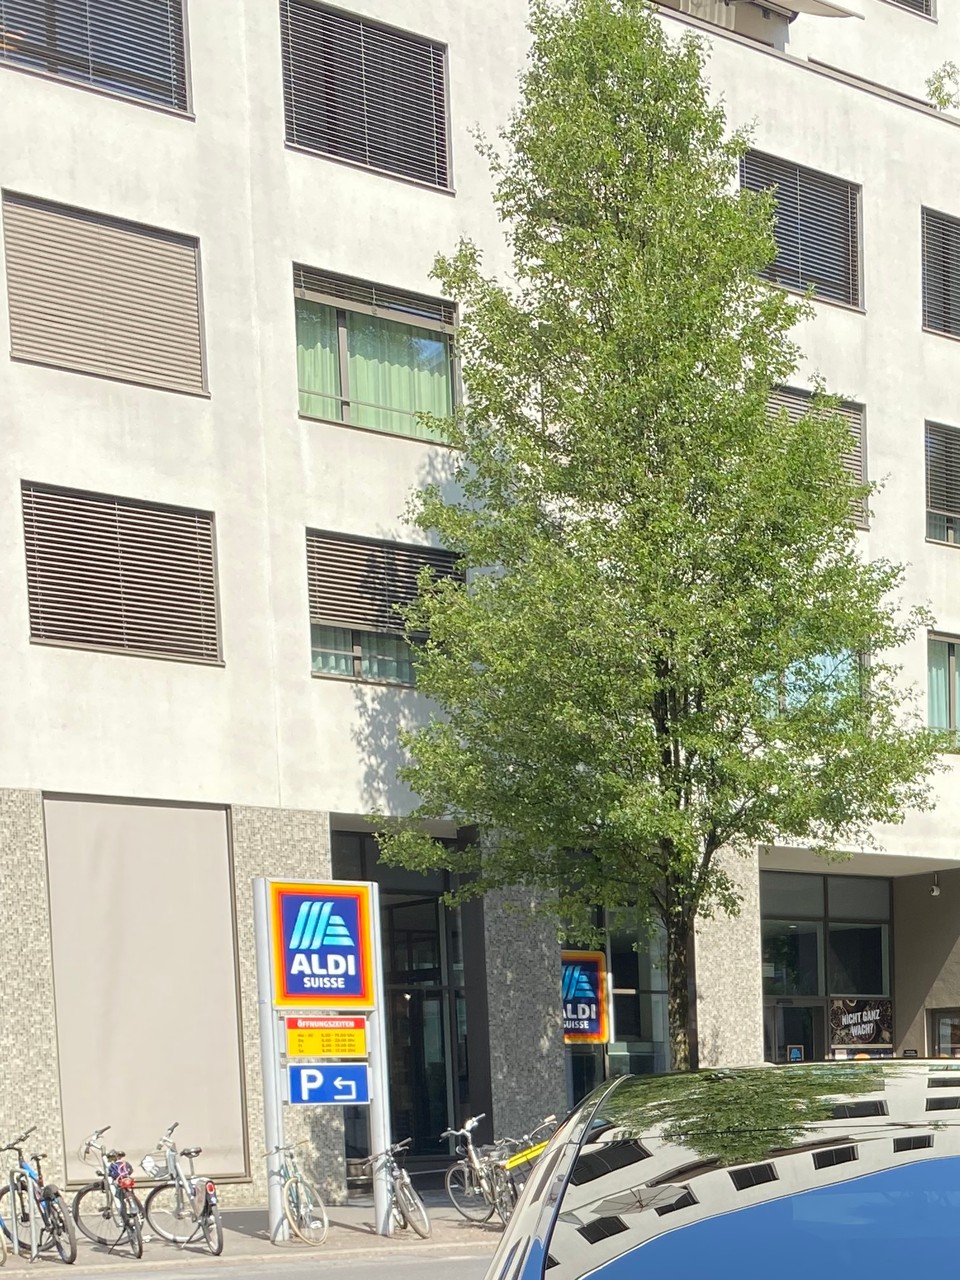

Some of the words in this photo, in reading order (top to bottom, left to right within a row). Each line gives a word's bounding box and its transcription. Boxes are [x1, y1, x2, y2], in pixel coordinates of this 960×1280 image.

[290, 953, 356, 975] ALDI
[303, 977, 345, 988] SUISSE
[297, 1018, 355, 1028] ÖFFNUNGSZEITEN
[842, 1011, 861, 1026] NICHT
[862, 1009, 881, 1022] GANZ
[850, 1023, 874, 1036] WACH?
[300, 1068, 324, 1101] P
